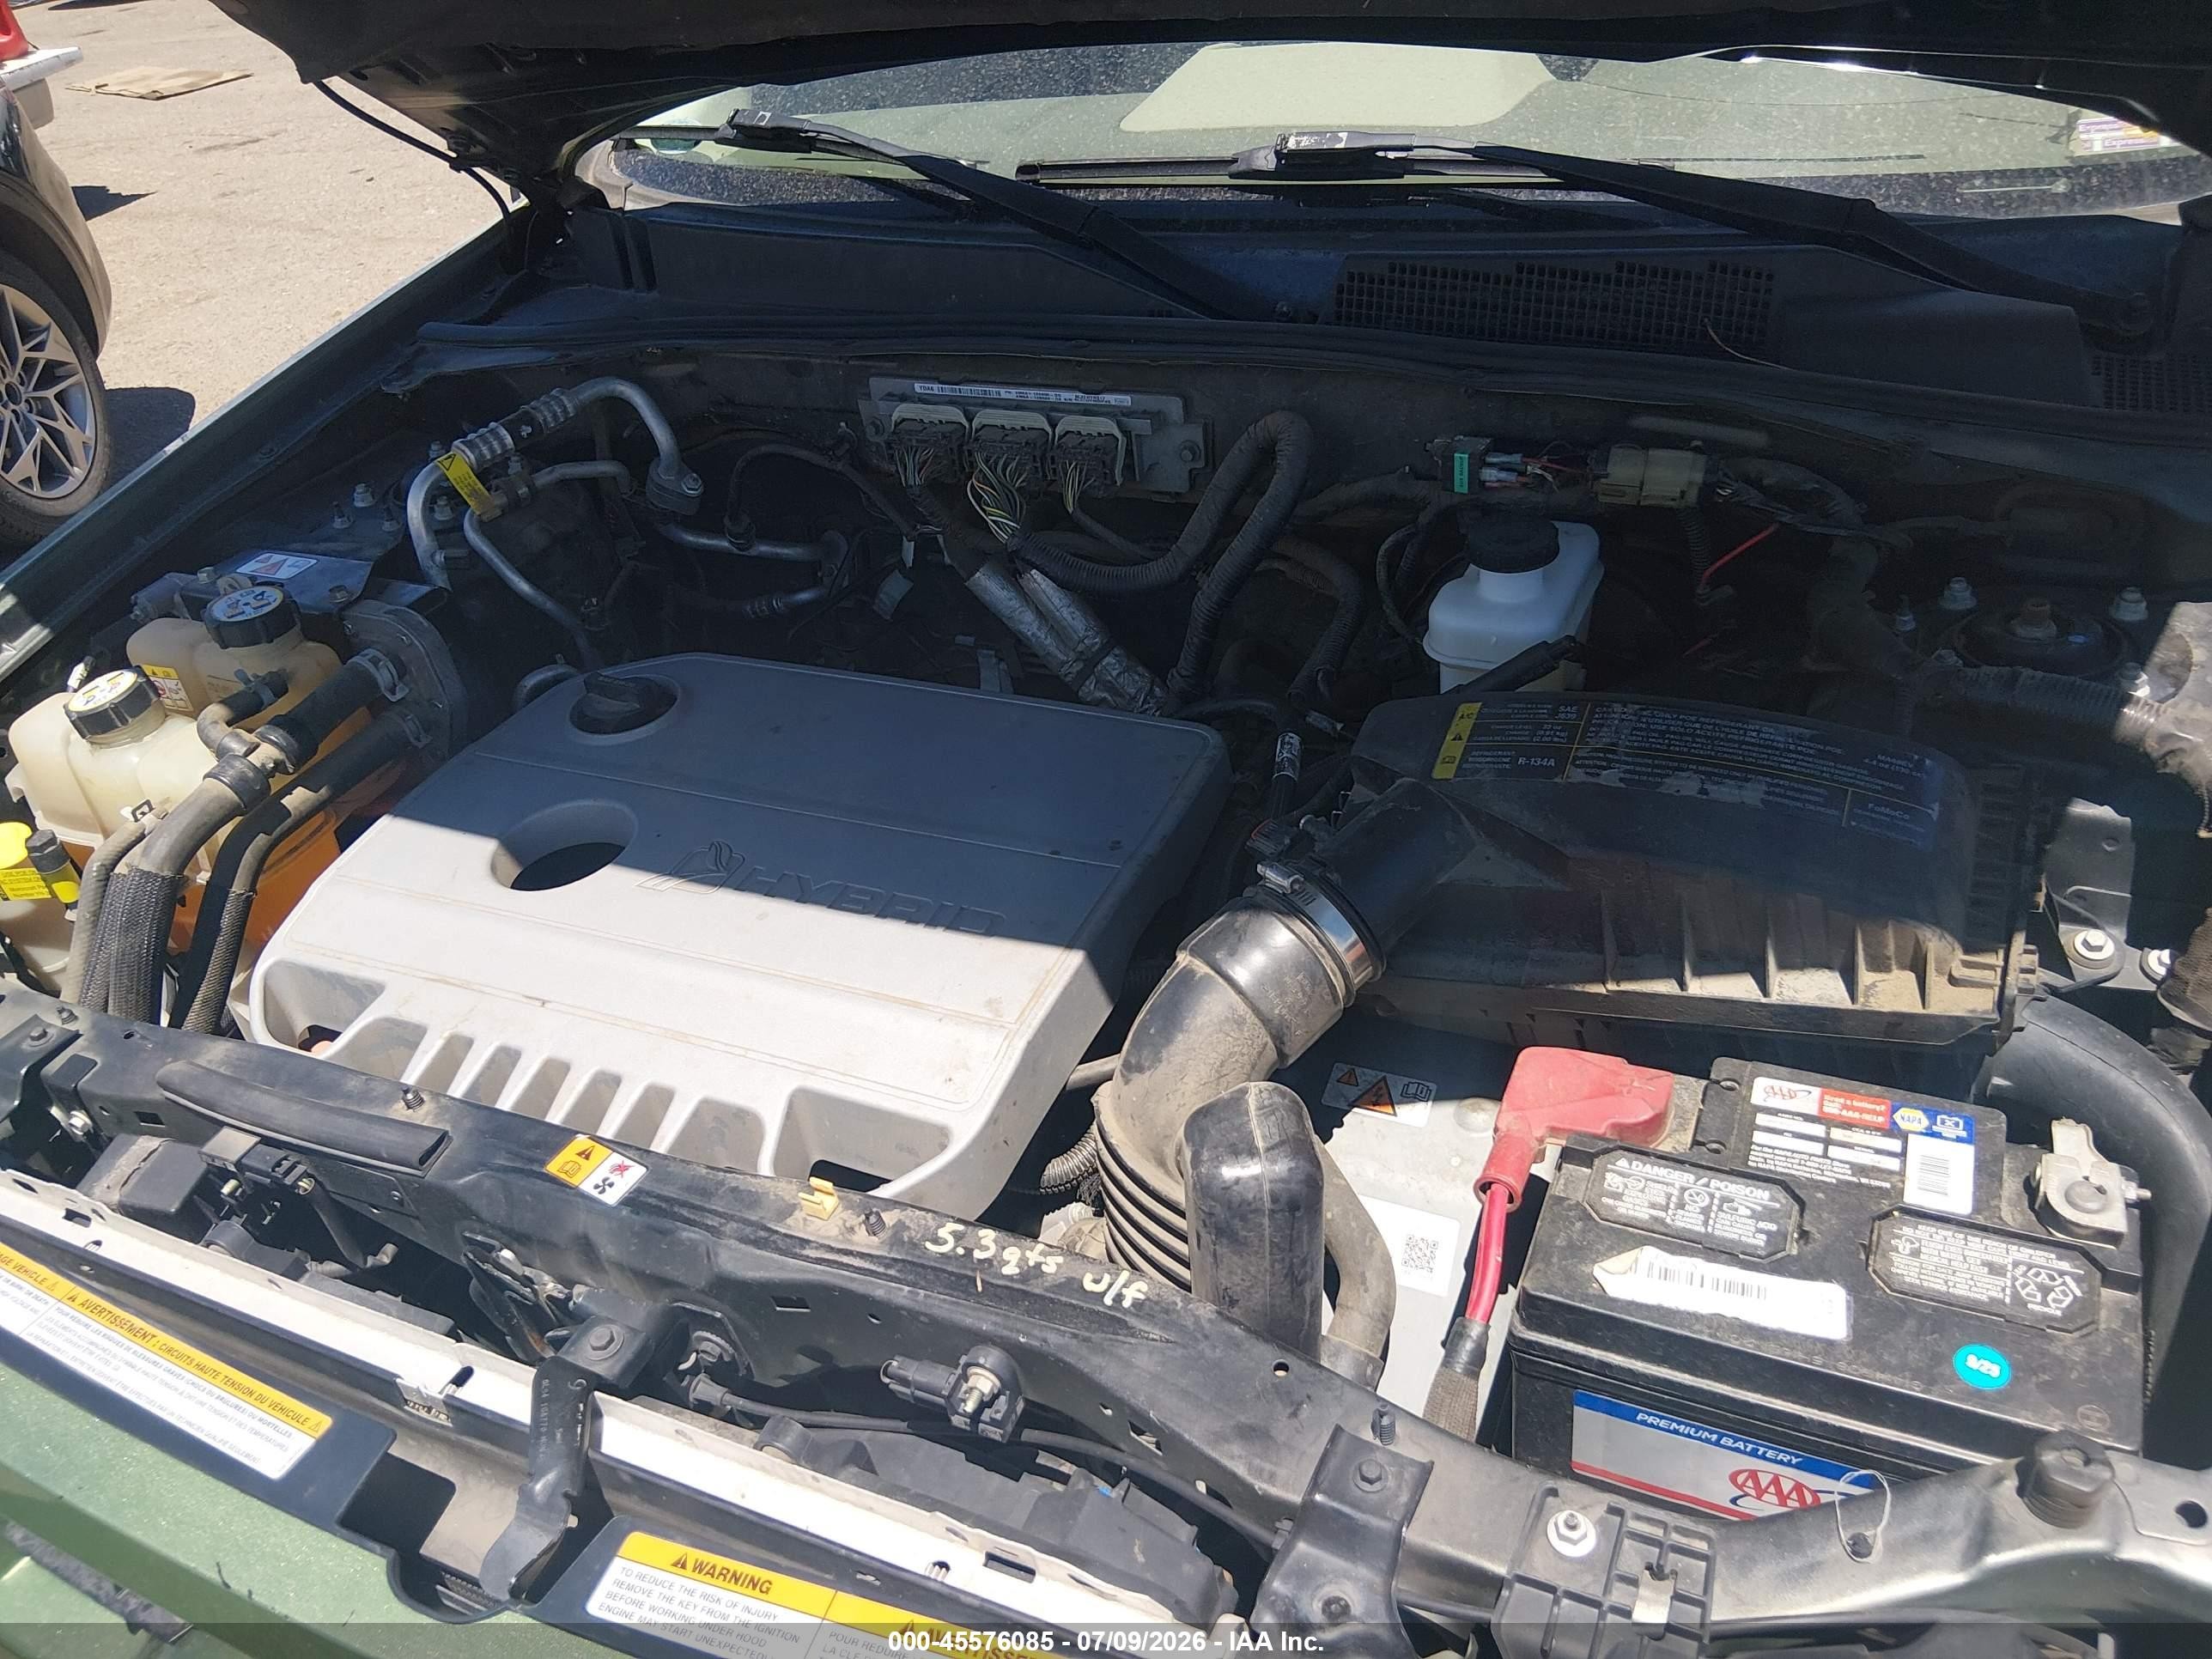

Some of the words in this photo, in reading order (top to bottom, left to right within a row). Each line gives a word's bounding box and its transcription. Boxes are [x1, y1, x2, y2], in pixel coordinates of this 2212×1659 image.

[1516, 757, 1556, 767] R-134A
[732, 866, 1006, 937] HYBRID
[1899, 1113, 1922, 1126] NAPA
[1632, 1160, 1695, 1183] DANGER
[1709, 1178, 1771, 1200] POISON
[77, 1298, 158, 1344] AVERTISSEMENT
[158, 1342, 194, 1365] CIRCUITS
[192, 1360, 222, 1380] HAUTE
[220, 1374, 258, 1399] TENSION
[254, 1392, 269, 1404] DU
[267, 1400, 312, 1426] VÉHICULE
[1636, 1412, 1717, 1442] PREMIUM
[1719, 1437, 1802, 1466] BATTERY
[1733, 1469, 1814, 1508] AAA
[621, 1566, 634, 1577] TO
[635, 1571, 676, 1591] REDUCE
[678, 1583, 698, 1596] THE
[699, 1588, 723, 1606] RISK
[726, 1595, 740, 1610] OF
[741, 1601, 779, 1622] INJURY
[691, 1558, 773, 1595] WARNING
[598, 1602, 635, 1622] ENGINE
[637, 1614, 659, 1631] MAY
[661, 1622, 694, 1639] START
[605, 1589, 646, 1611] BEFORE
[647, 1602, 696, 1626] WORKING
[697, 1619, 735, 1638] UNDER
[735, 1630, 769, 1649] HOOD
[612, 1578, 654, 1599] REMOVE
[657, 1590, 677, 1605] THE
[678, 1597, 699, 1612] KEY
[700, 1605, 730, 1623] FROM
[732, 1614, 753, 1630] THE
[754, 1623, 800, 1644] IGNITION
[829, 1631, 860, 1646] POUR
